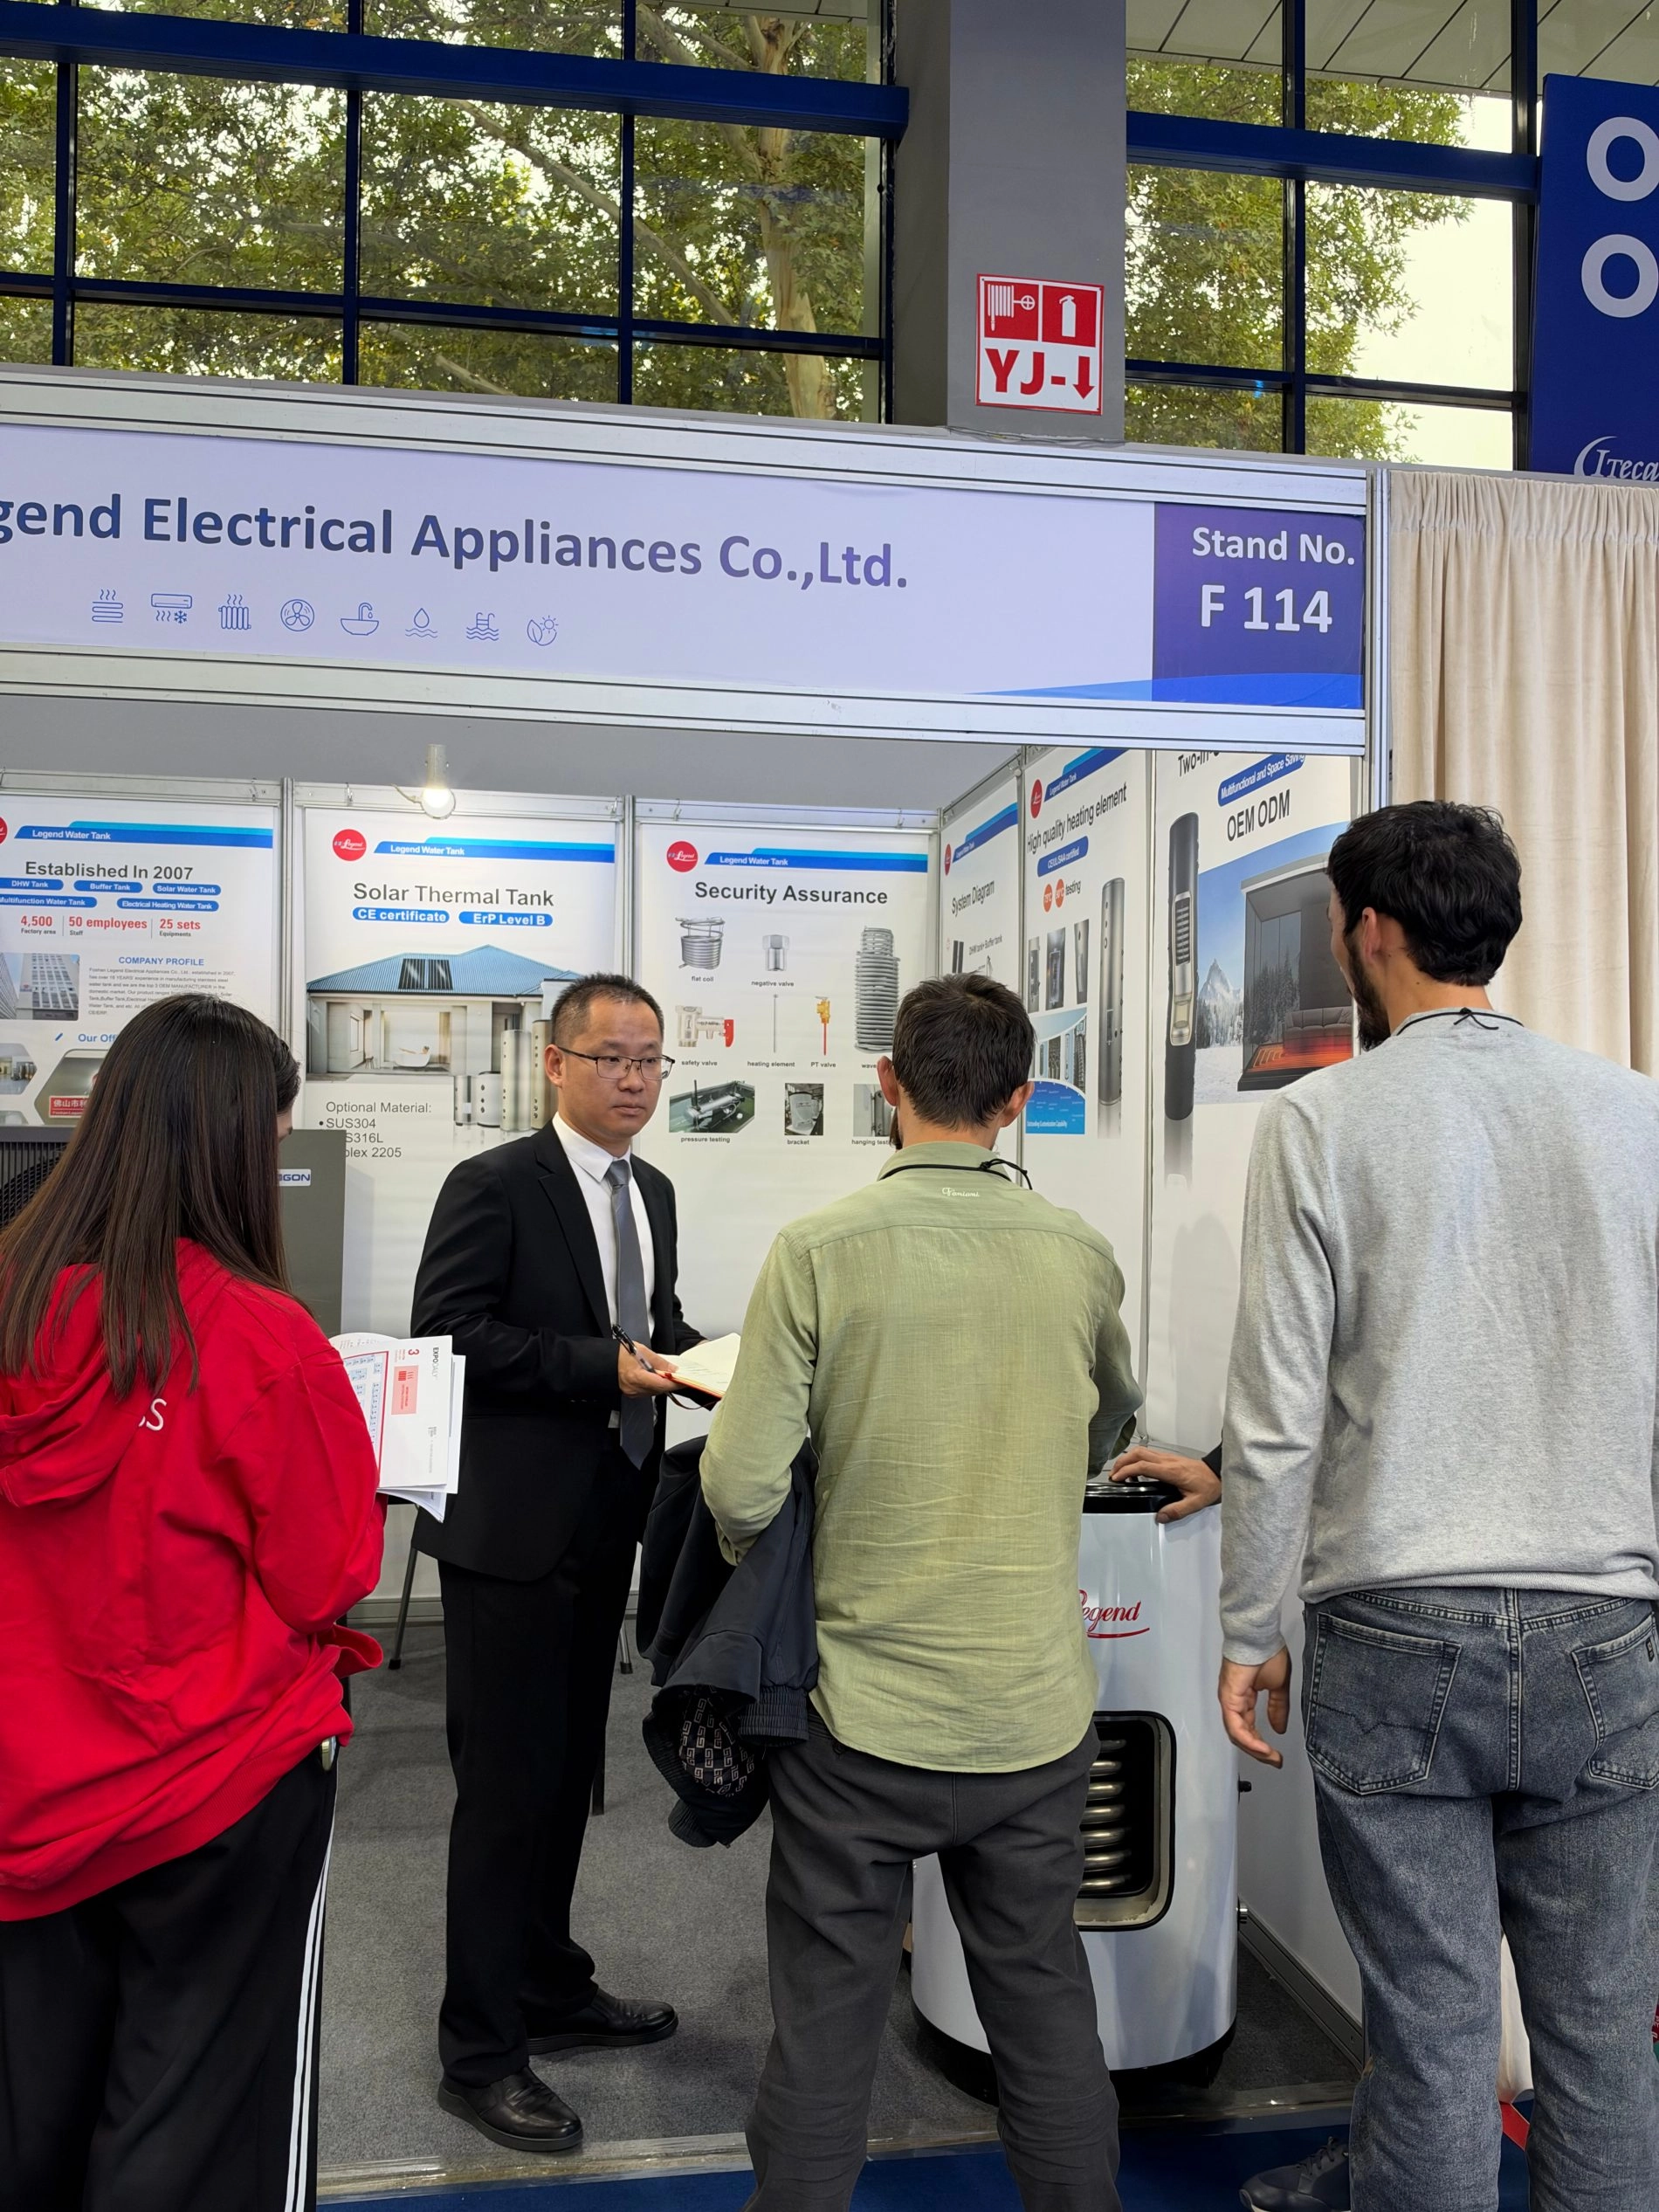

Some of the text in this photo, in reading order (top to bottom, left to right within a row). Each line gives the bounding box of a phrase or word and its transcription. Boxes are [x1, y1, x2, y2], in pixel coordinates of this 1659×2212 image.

[143, 497, 392, 554] Electrical
[410, 514, 702, 575] Appliances
[719, 534, 908, 590] Co.,Ltd.
[1193, 527, 1355, 565] Stand No.
[1201, 584, 1332, 632] F 114
[1222, 771, 1256, 799] Multifunctional
[1256, 765, 1266, 781] and
[1267, 760, 1284, 777] Space
[1028, 782, 1126, 854] High quality heating element
[1228, 789, 1290, 841] OEM ODM
[32, 830, 111, 840] Legend Water Tank
[390, 844, 420, 855] Legend
[422, 846, 444, 855] Water
[719, 856, 747, 865] Legend
[748, 857, 769, 865] Water
[25, 861, 193, 880] Established In 2007
[353, 883, 554, 906] Solar Thermal Tank
[695, 882, 888, 904] Security Assurance
[1066, 880, 1081, 896] testing
[952, 880, 995, 917] System Diagram
[21, 915, 52, 927] 4,500
[358, 909, 447, 923] CE certificate
[473, 913, 546, 926] ErP Level B
[69, 916, 148, 931] 50 employees
[160, 919, 201, 930] 25 sets
[119, 956, 163, 965] COMPANY
[78, 1033, 97, 1043] Our
[326, 1101, 431, 1114] Optional Material:
[326, 1118, 376, 1128] SUS304
[346, 1133, 383, 1143] S316L
[371, 1147, 402, 1158] 2205
